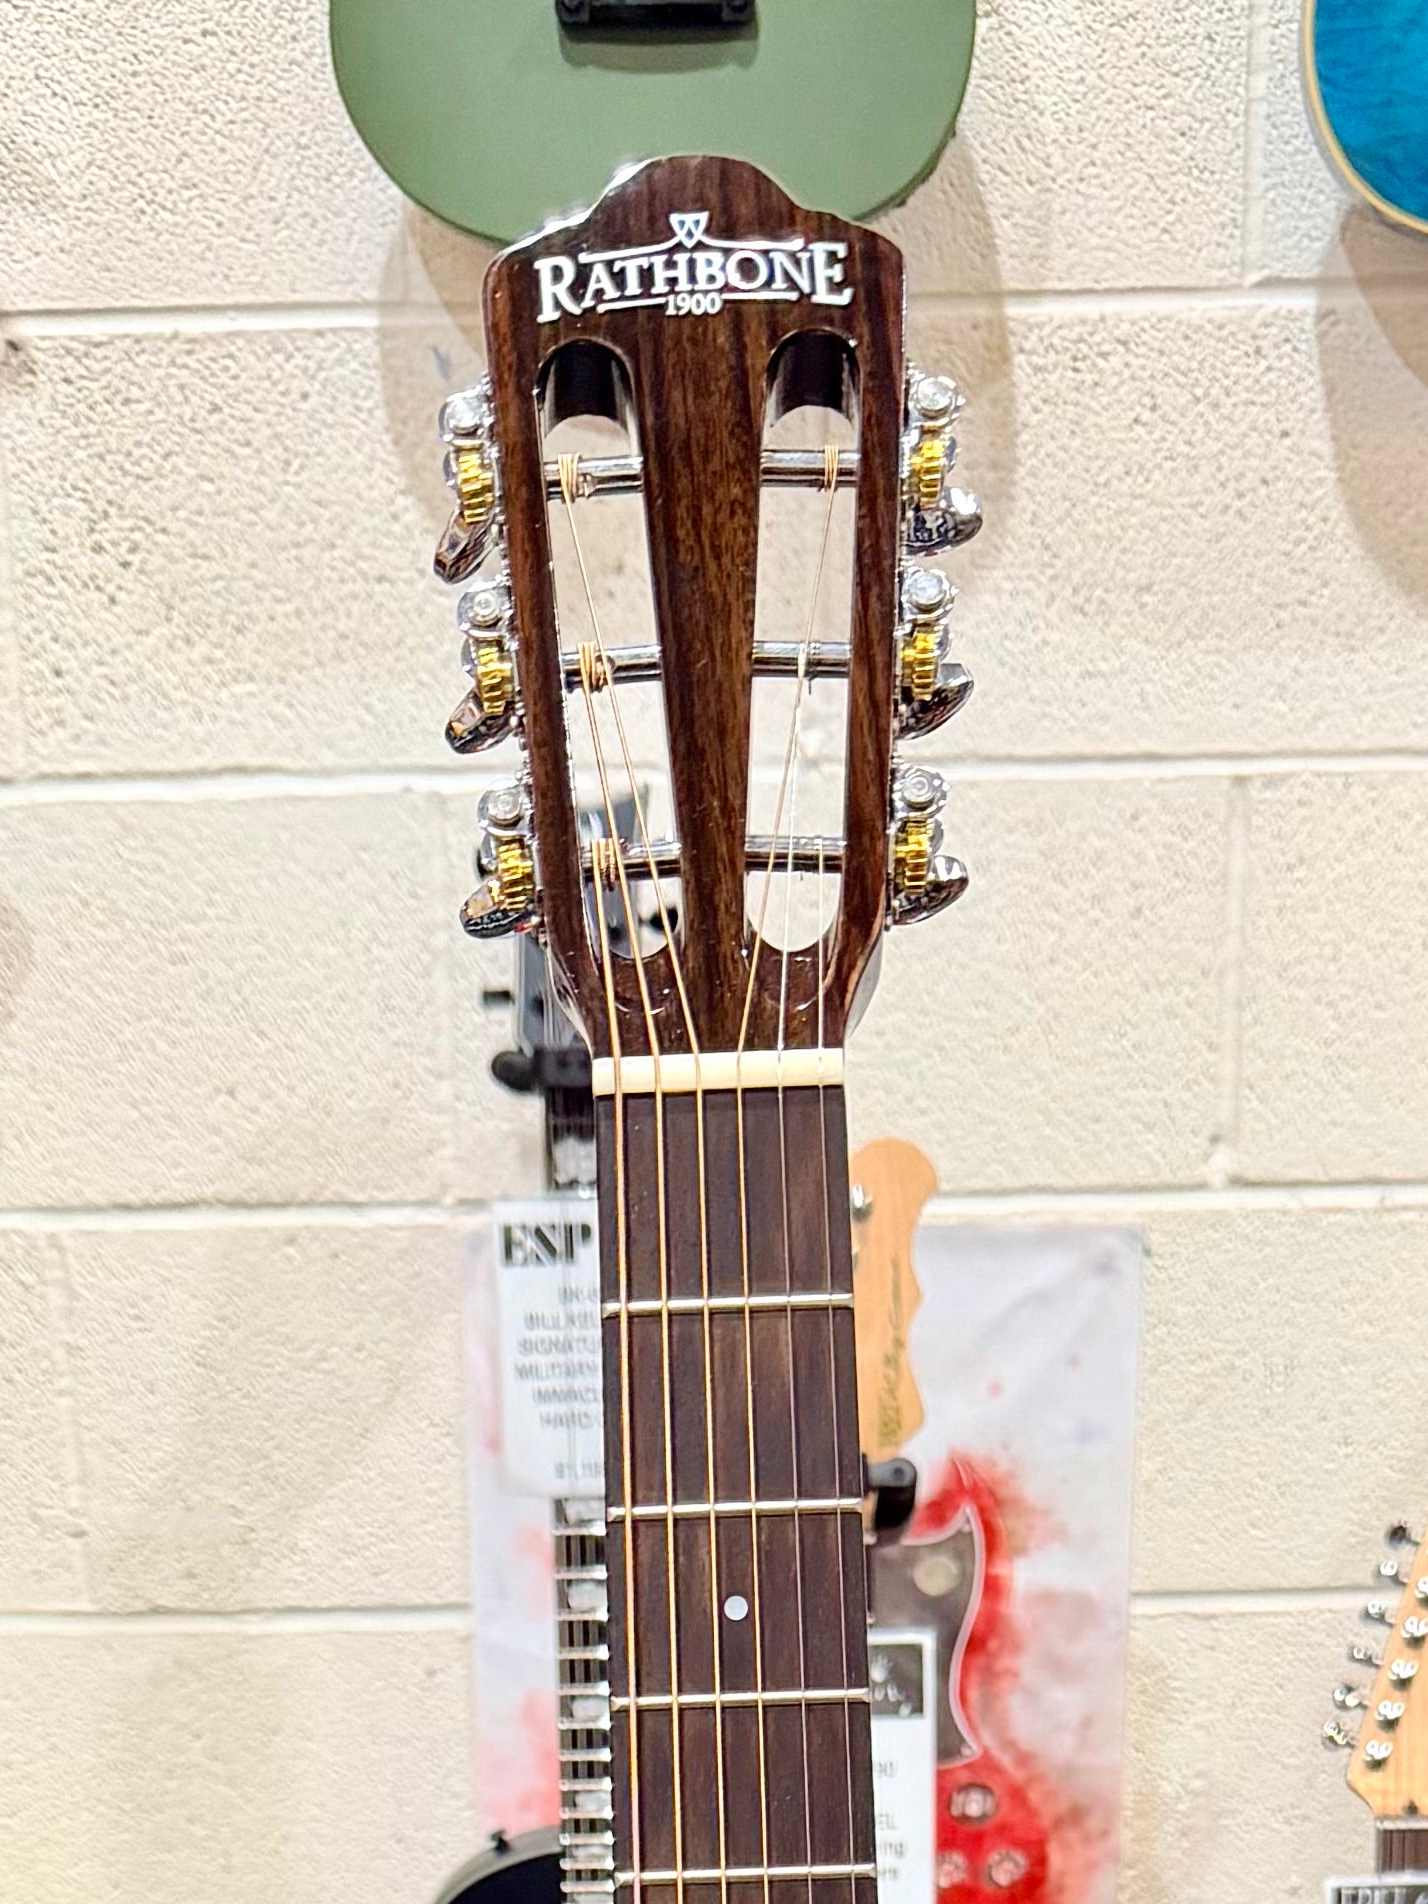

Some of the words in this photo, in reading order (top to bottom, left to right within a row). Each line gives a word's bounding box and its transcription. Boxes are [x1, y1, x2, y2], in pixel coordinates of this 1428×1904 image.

[534, 242, 855, 324] RATHBONE
[665, 292, 722, 316] 1900
[501, 1222, 592, 1267] ESP
